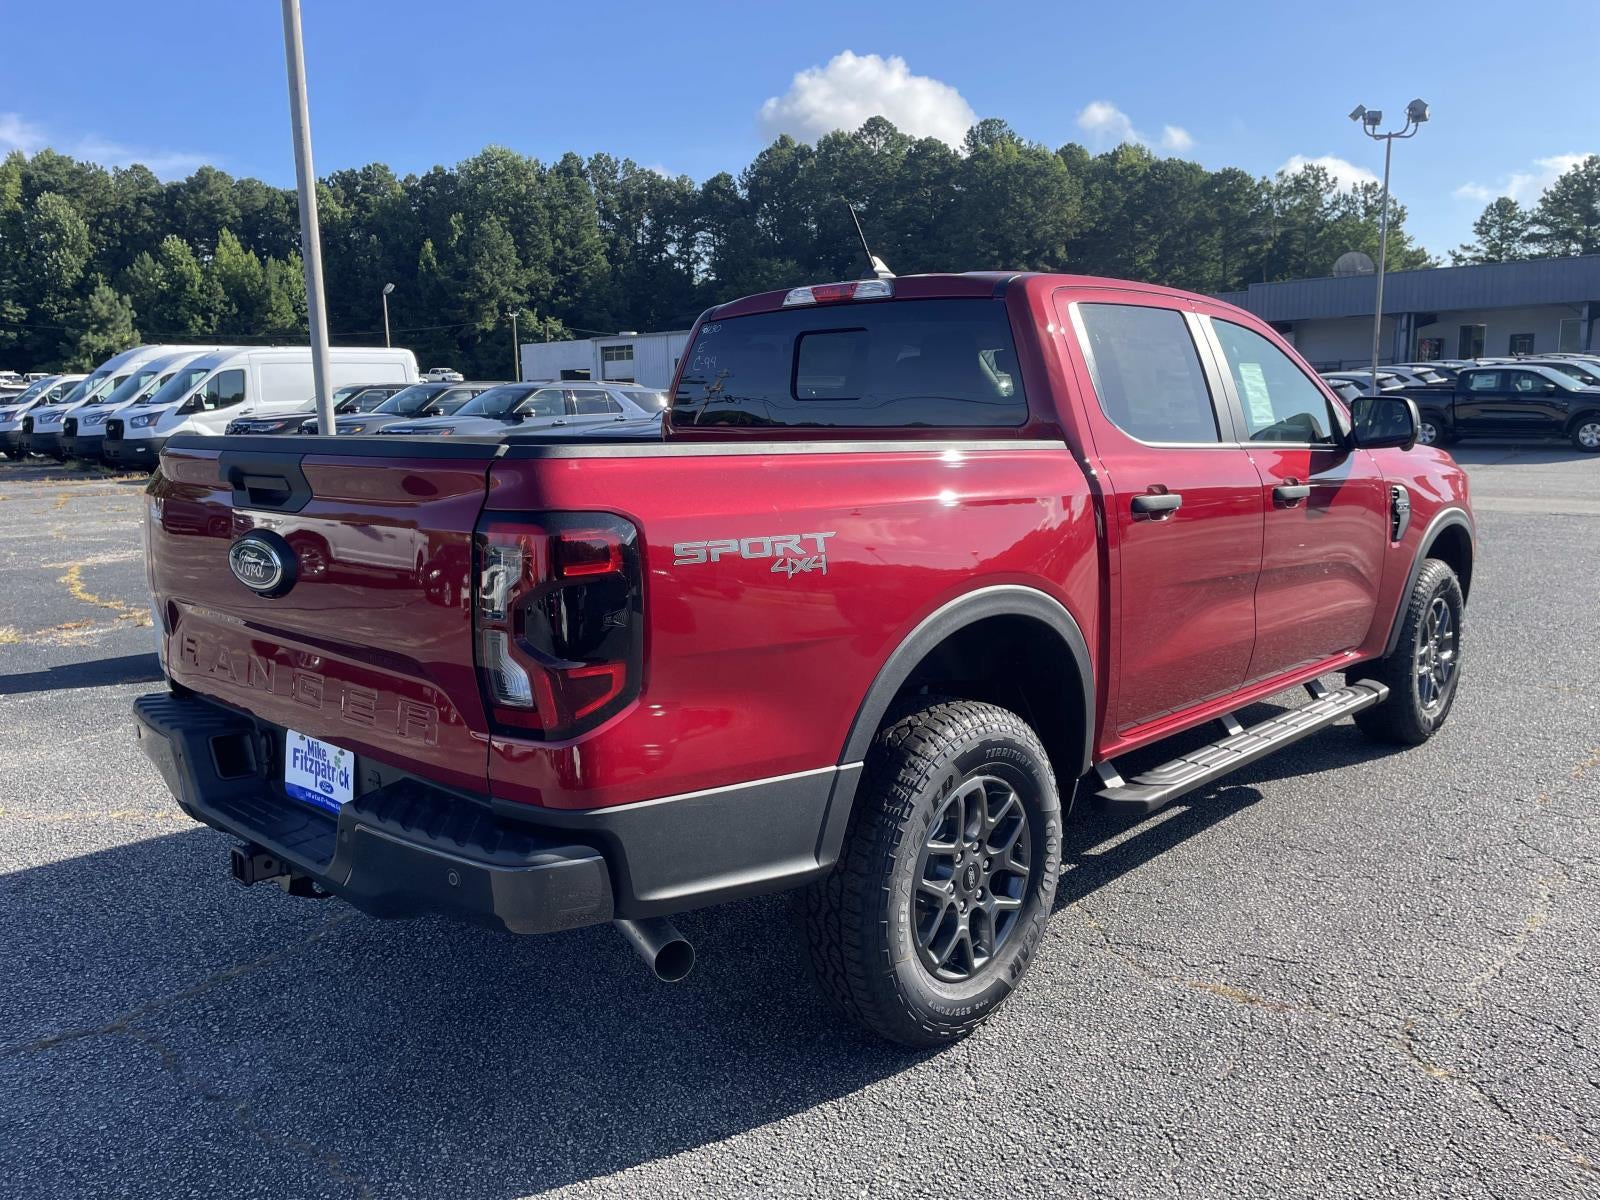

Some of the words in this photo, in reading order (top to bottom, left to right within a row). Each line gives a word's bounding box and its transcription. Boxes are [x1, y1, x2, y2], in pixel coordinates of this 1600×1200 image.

[237, 549, 265, 578] Ford
[673, 531, 837, 566] SPORT
[180, 636, 440, 748] RANGER
[307, 738, 327, 762] Mike
[985, 747, 1032, 768] TERRITORY
[292, 747, 350, 791] Fitzpatrick
